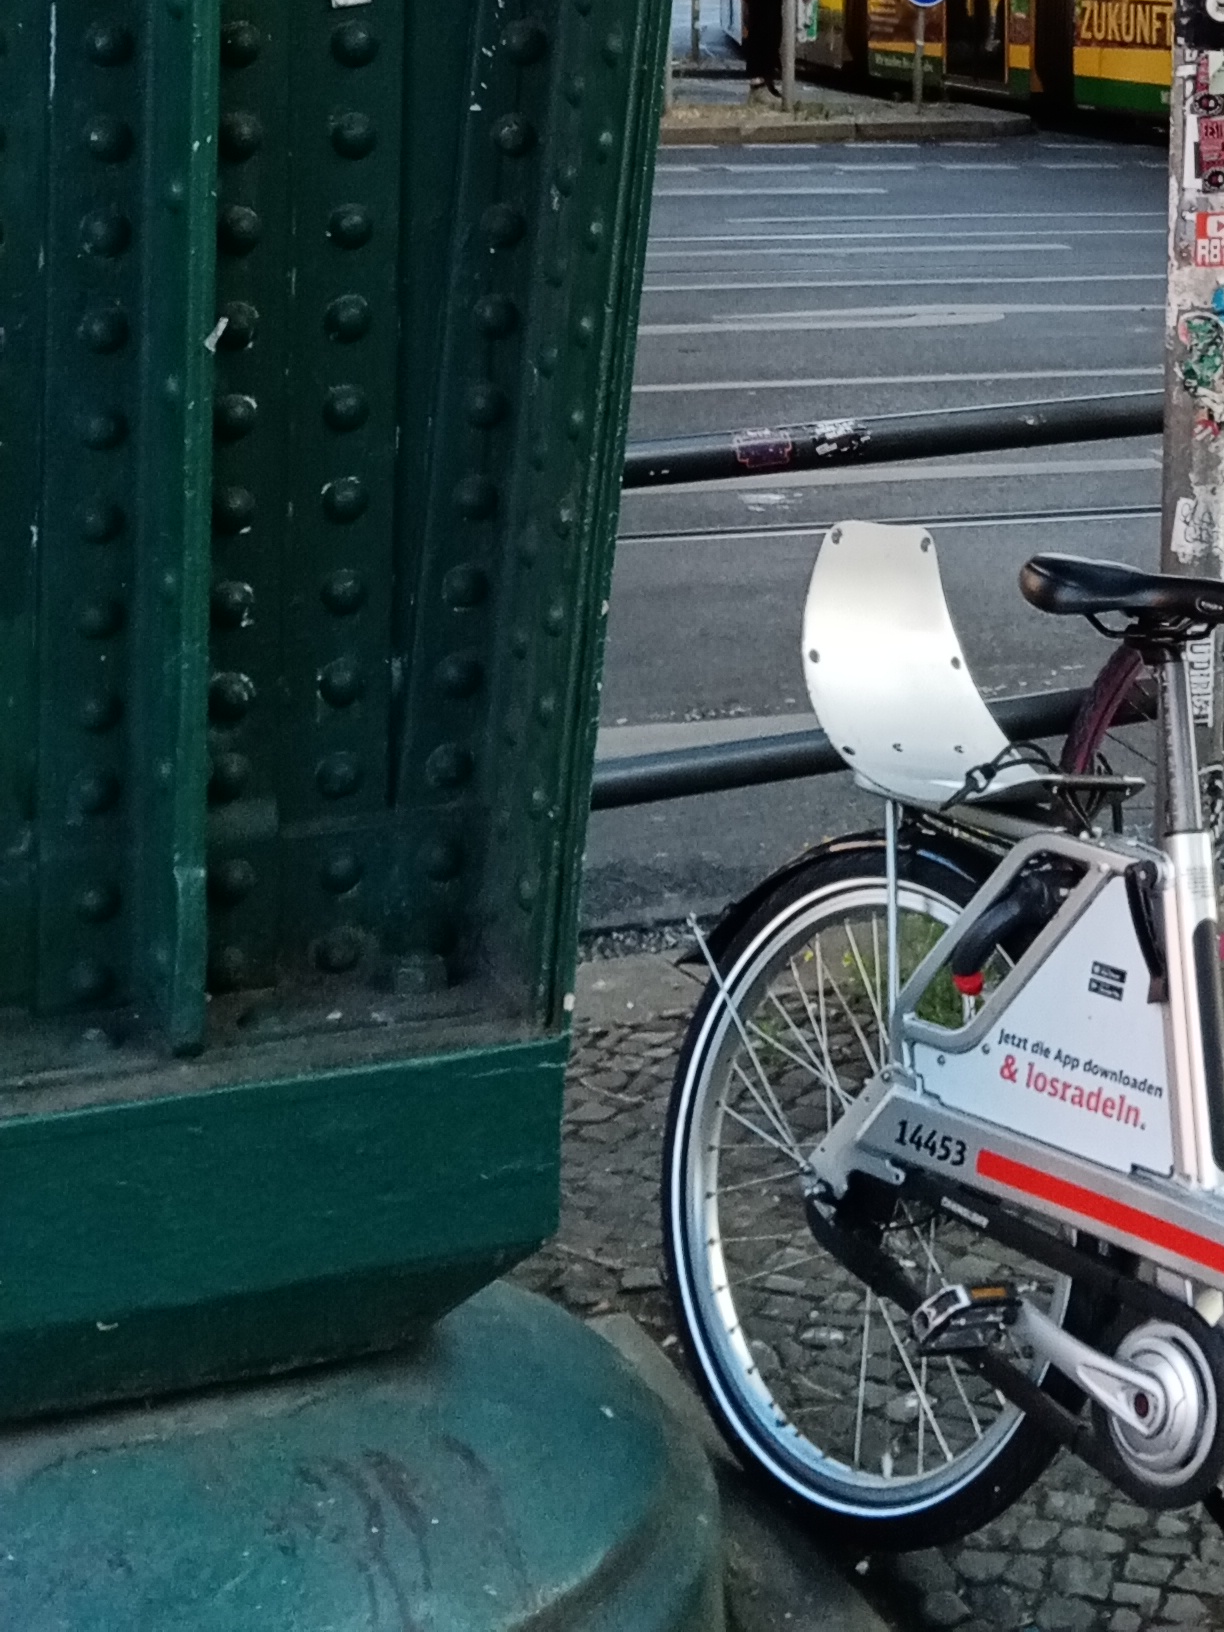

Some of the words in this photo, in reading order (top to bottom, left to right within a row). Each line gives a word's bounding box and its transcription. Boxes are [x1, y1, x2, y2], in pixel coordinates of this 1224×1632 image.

[999, 1028, 1028, 1053] Jetzt
[1031, 1040, 1051, 1059] die
[1053, 1047, 1080, 1072] App
[1083, 1057, 1164, 1099] downloaden
[999, 1053, 1019, 1085] &
[1026, 1060, 1147, 1131] losradeln.
[895, 1118, 967, 1167] 14453
